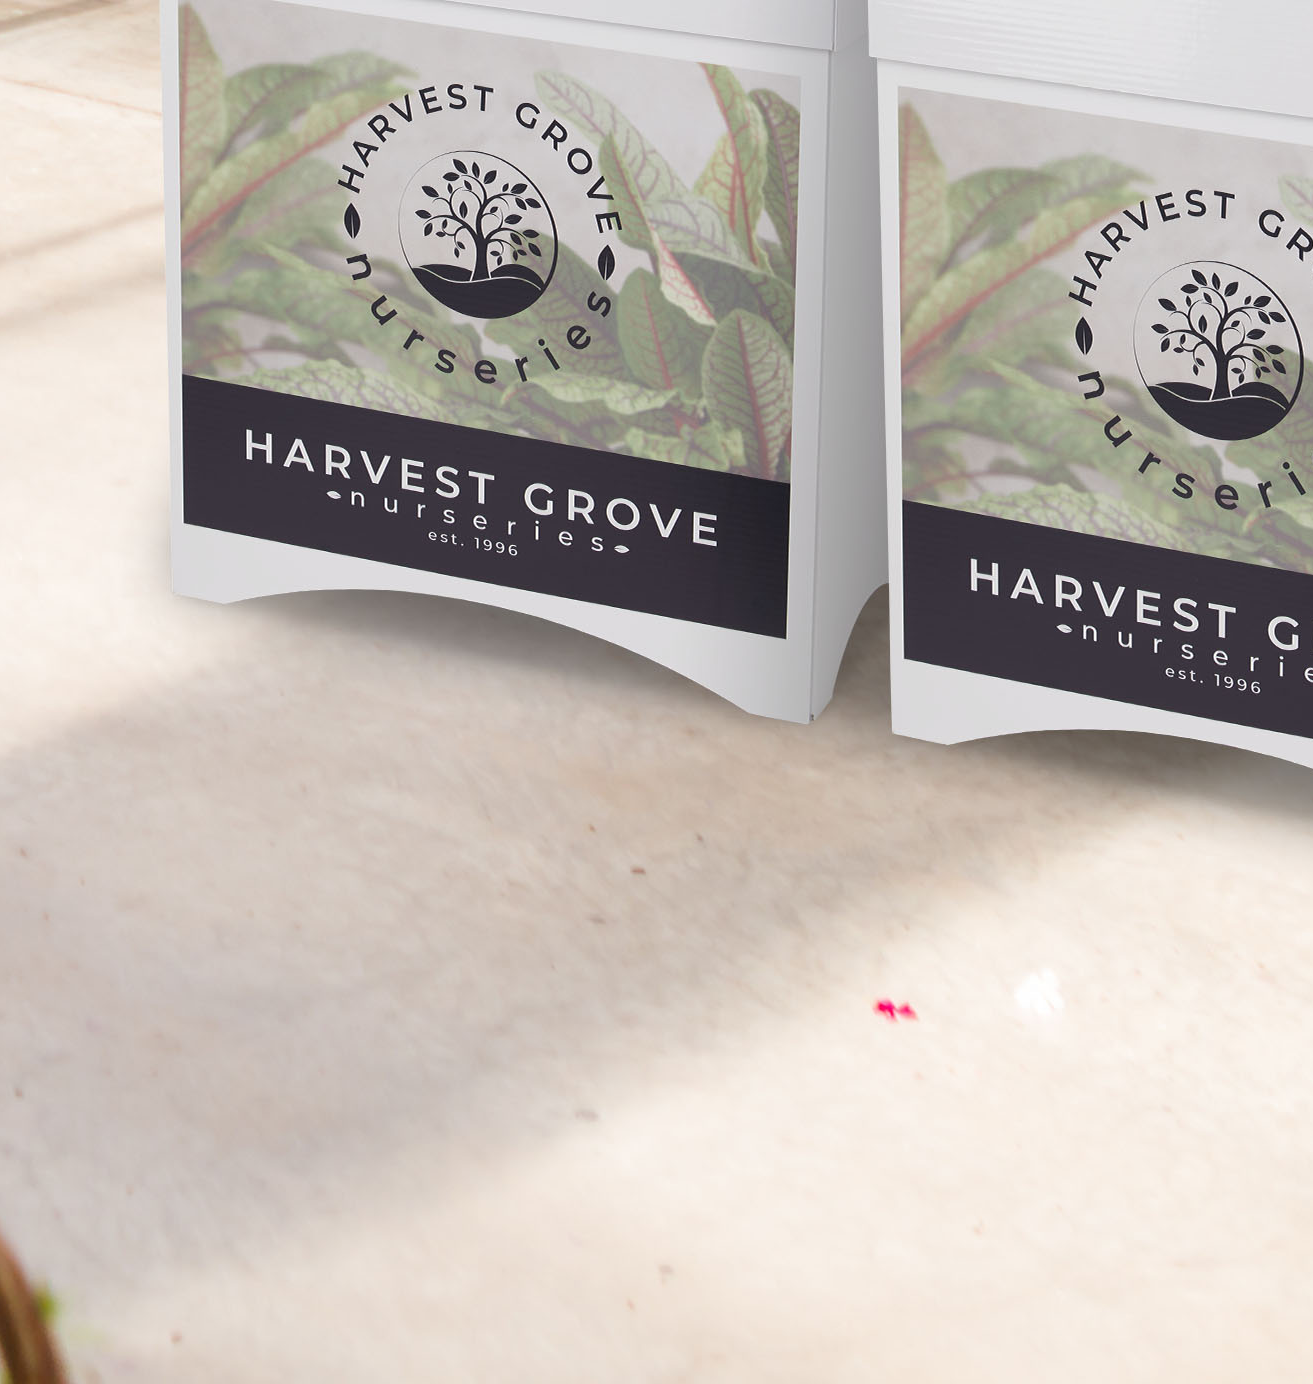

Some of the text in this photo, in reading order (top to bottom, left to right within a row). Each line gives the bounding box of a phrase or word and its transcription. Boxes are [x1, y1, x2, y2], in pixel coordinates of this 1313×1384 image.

[337, 83, 623, 234] HARVEST GROVE
[1068, 189, 1235, 307] HARVEST
[346, 253, 612, 384] nurseries
[245, 428, 718, 547] HARVEST GROVE
[351, 490, 604, 552] nurseries
[428, 530, 518, 557] est. 1996
[970, 558, 1237, 639] HARVEST
[1165, 666, 1262, 694] est. 1996
